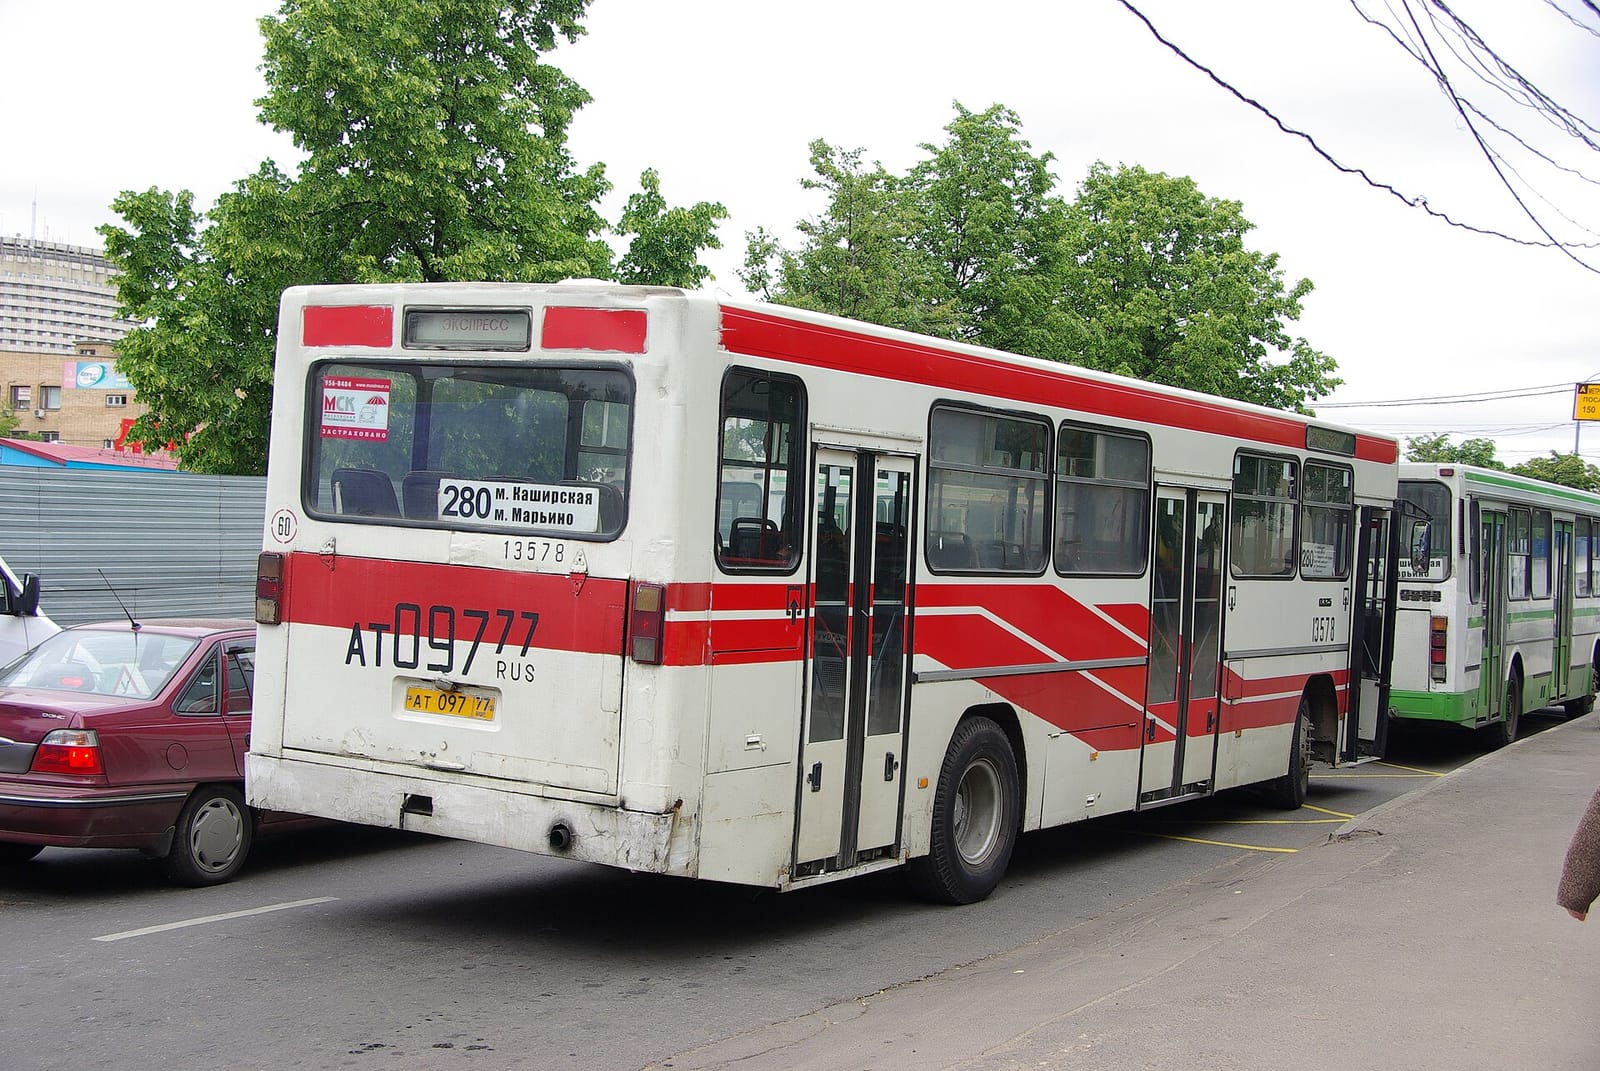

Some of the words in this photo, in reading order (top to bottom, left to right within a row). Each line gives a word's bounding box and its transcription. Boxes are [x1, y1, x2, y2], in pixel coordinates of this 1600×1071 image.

[442, 318, 510, 331] ЭКСПРЕСС
[324, 395, 355, 412] МСК
[322, 428, 387, 438] ЗАСТРАХОВАНО
[442, 485, 491, 519] 280
[513, 486, 593, 505] Каширская
[511, 507, 574, 525] Марьино
[278, 516, 291, 537] 60
[503, 540, 565, 562] 13578
[1301, 549, 1313, 568] 280
[1312, 617, 1336, 643] 13578
[496, 660, 536, 683] RUS
[438, 693, 466, 713] 097
[475, 697, 491, 711] 77
